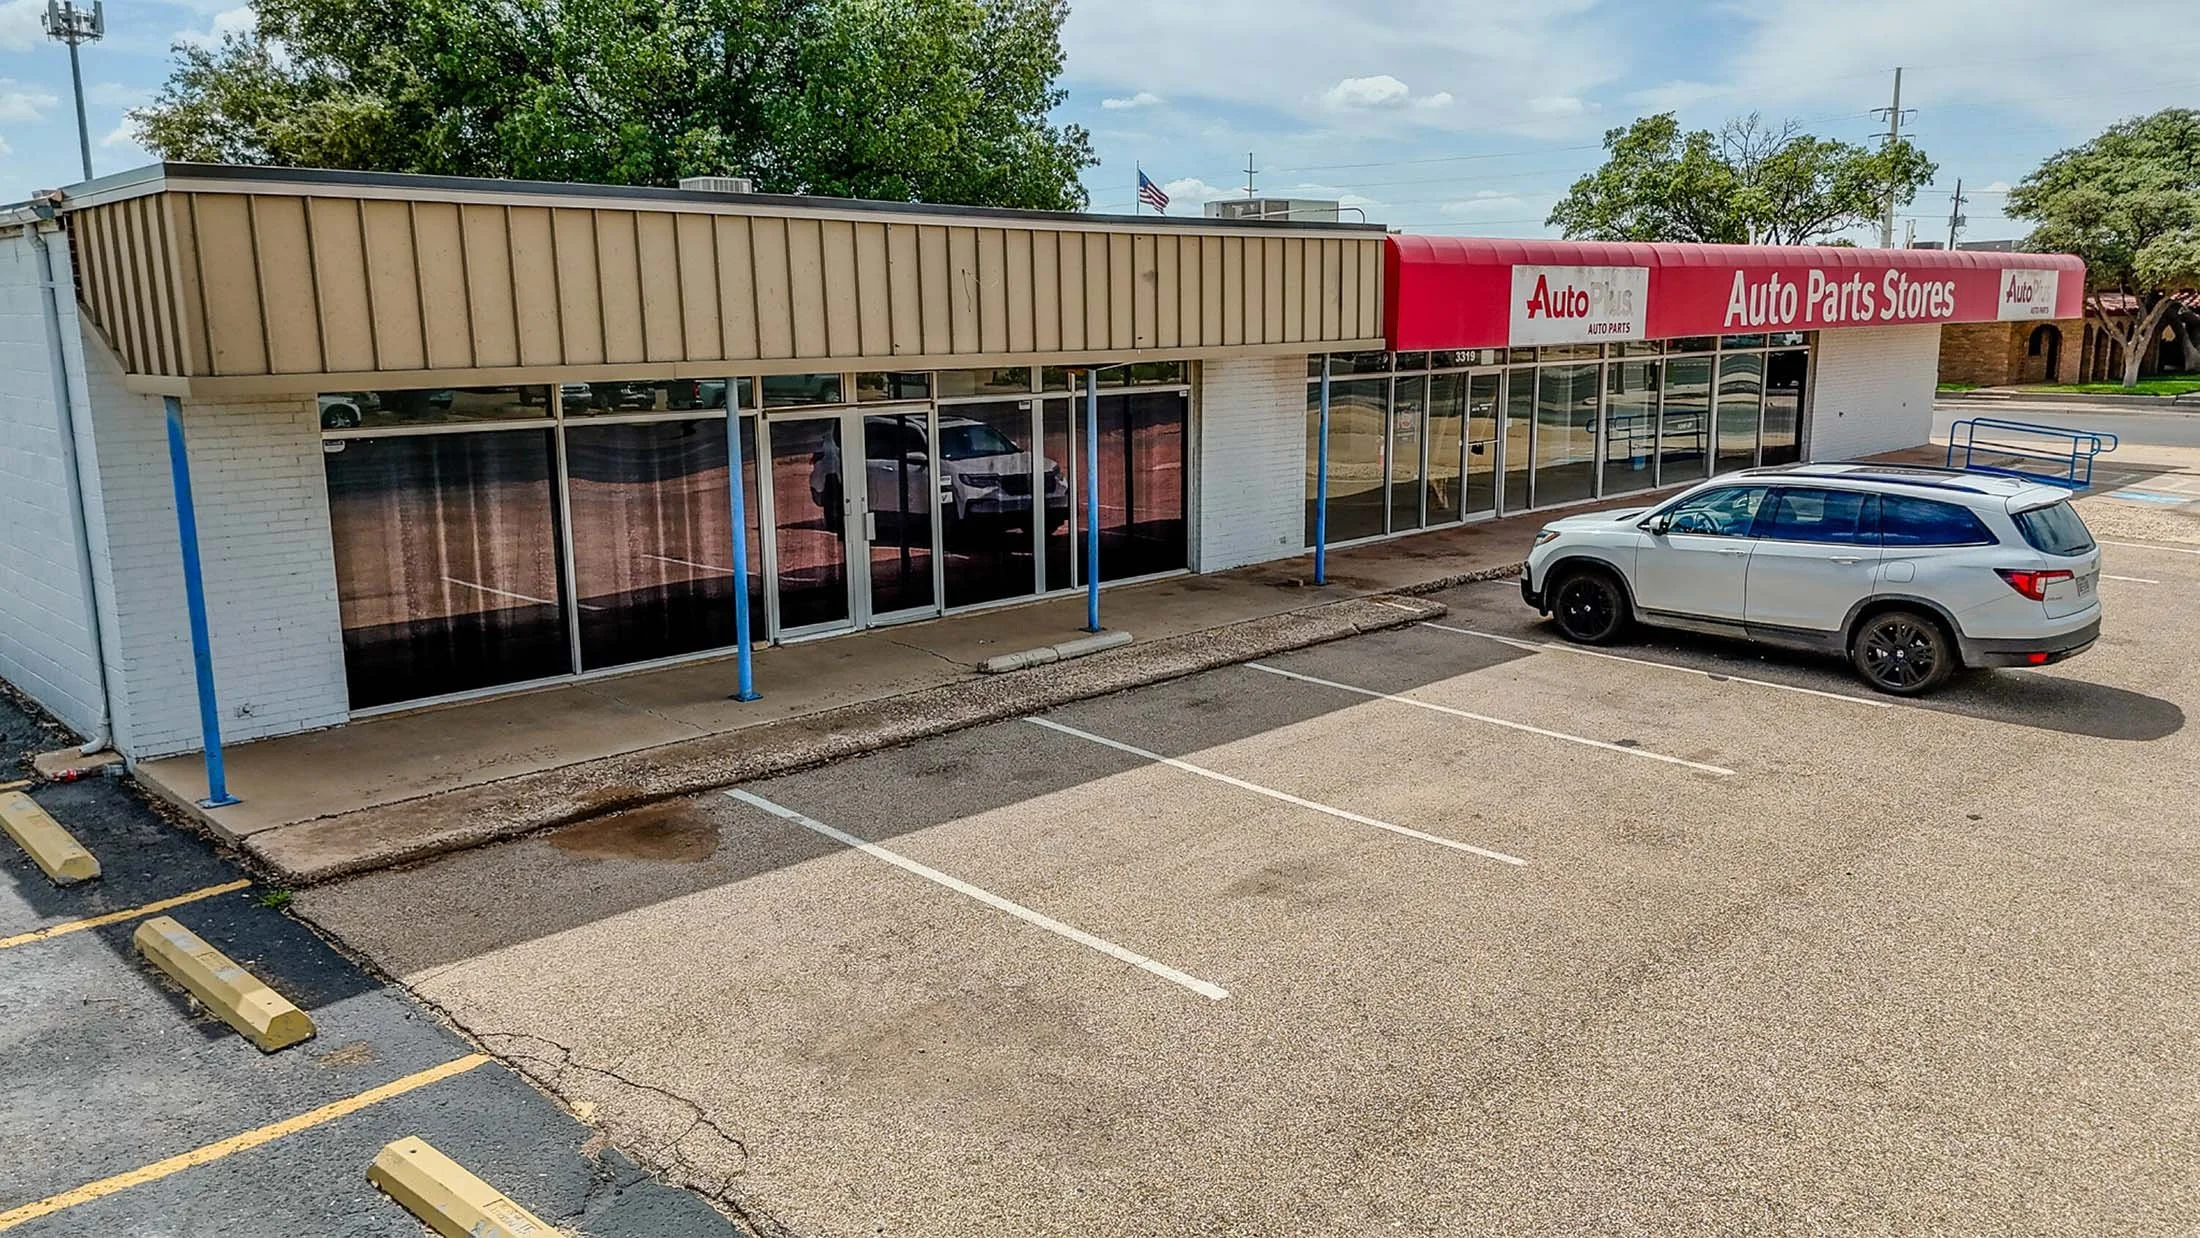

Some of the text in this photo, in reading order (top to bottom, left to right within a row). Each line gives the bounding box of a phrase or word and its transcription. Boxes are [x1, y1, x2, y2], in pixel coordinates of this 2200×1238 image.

[1723, 268, 1955, 327] Auto Parts Stores
[1588, 322, 1631, 335] AUTO PARTS
[1455, 350, 1476, 362] 3319
